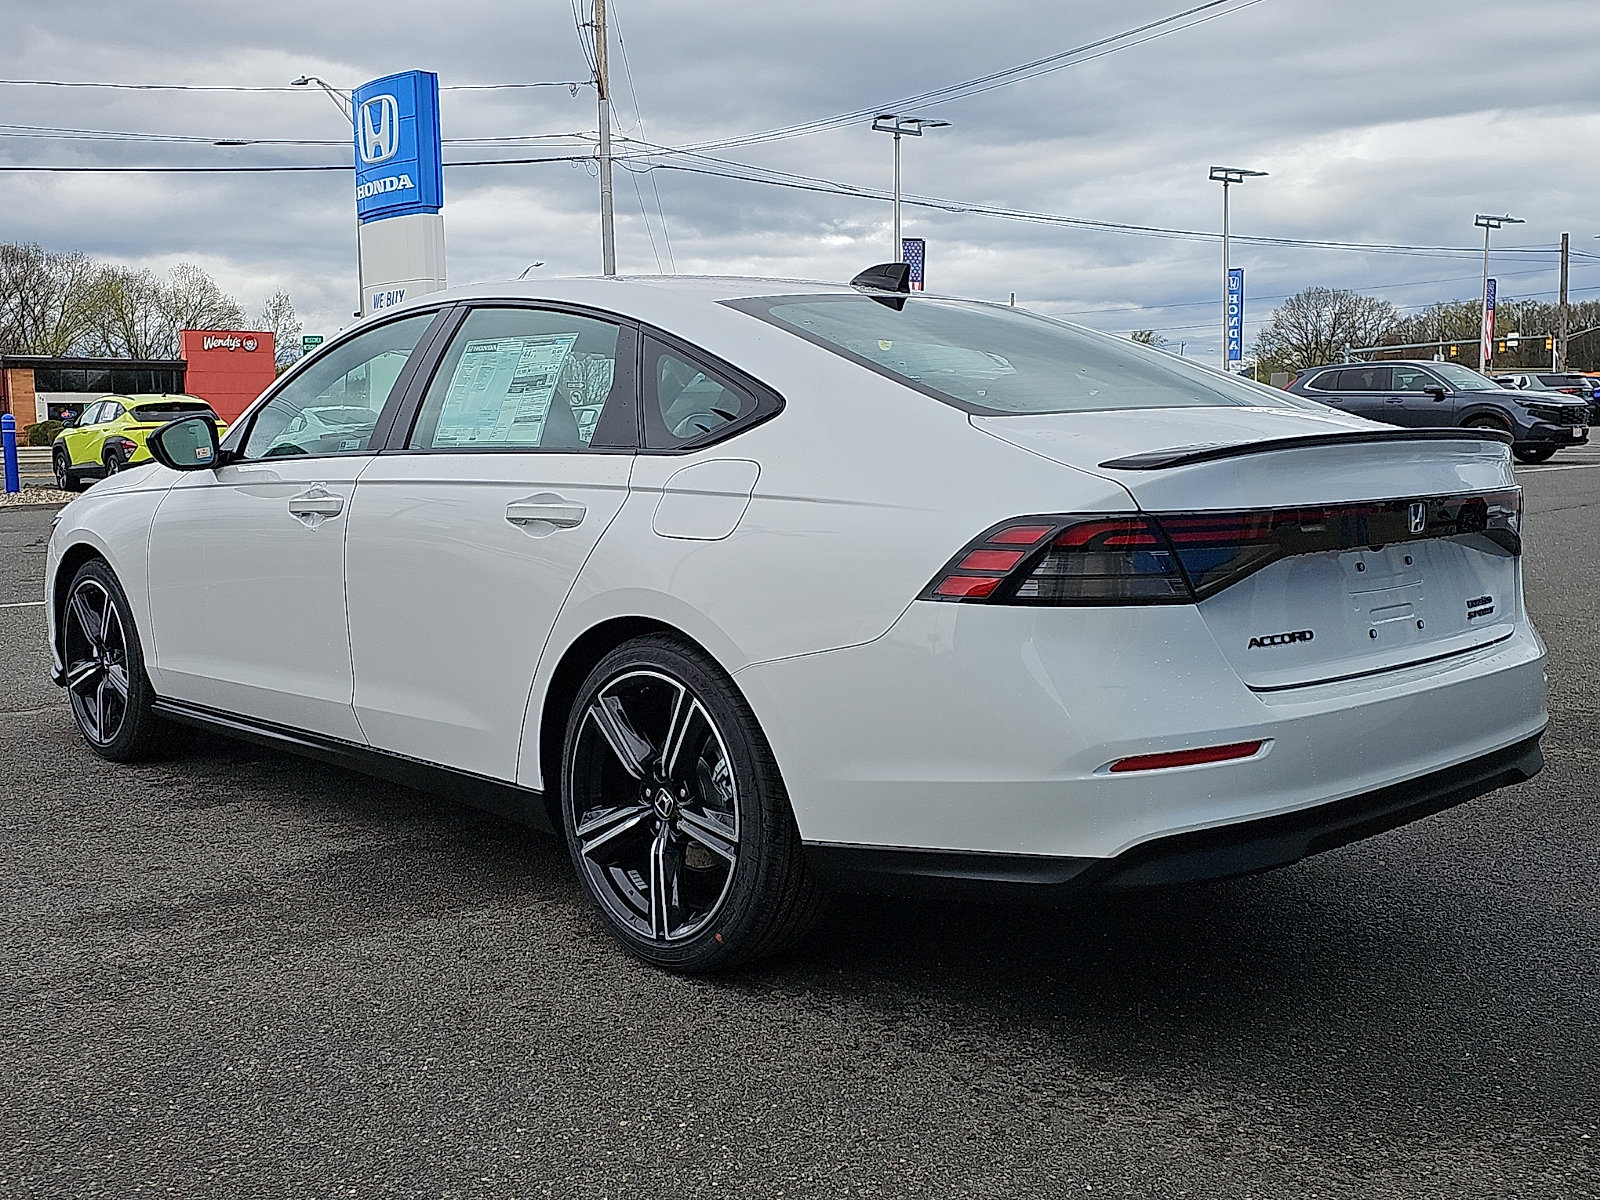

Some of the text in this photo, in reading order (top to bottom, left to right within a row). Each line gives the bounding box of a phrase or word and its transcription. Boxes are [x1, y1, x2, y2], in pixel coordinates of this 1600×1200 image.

[357, 174, 415, 200] HONDA
[373, 290, 405, 309] WE BUY
[203, 334, 241, 351] Wendy's
[1247, 630, 1314, 649] ACCORD
